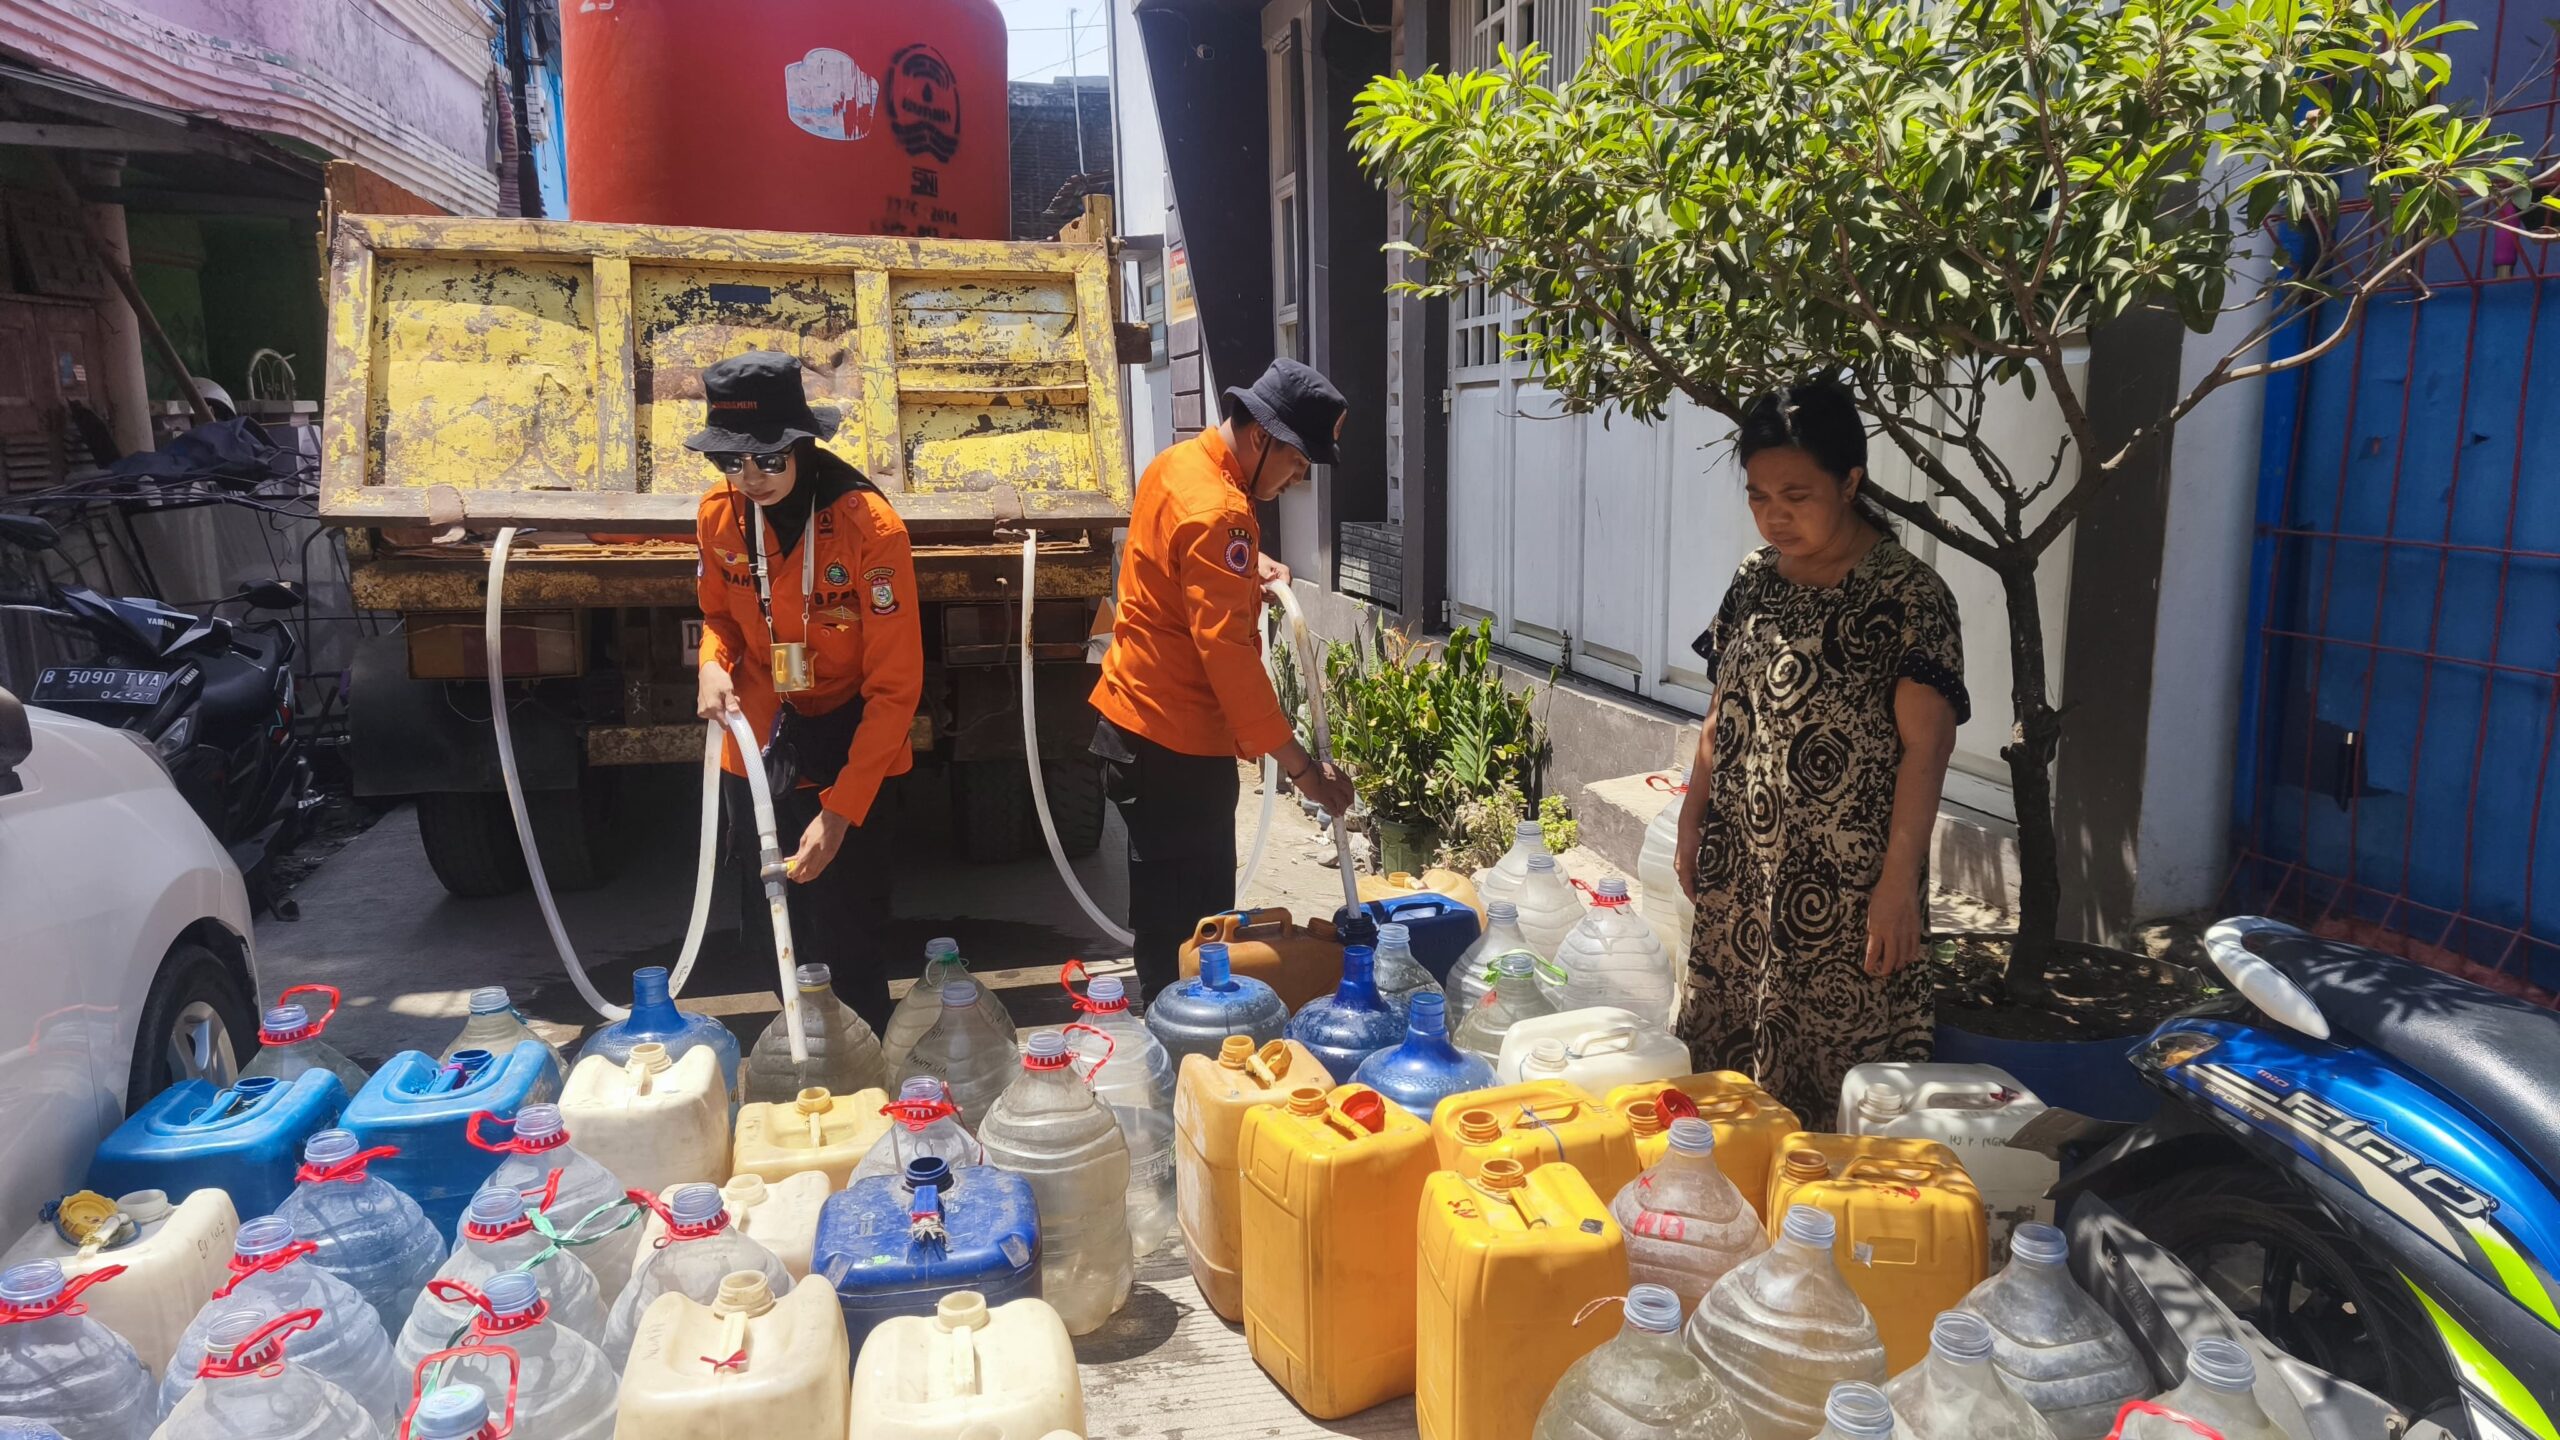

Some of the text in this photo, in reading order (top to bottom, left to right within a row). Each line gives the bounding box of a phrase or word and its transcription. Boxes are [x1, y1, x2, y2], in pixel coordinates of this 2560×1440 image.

[147, 617, 175, 630] YAMAHA
[43, 670, 160, 687] B 5090 TVA
[180, 667, 200, 687] YAMAHA
[2204, 1083, 2266, 1121] SPORTS
